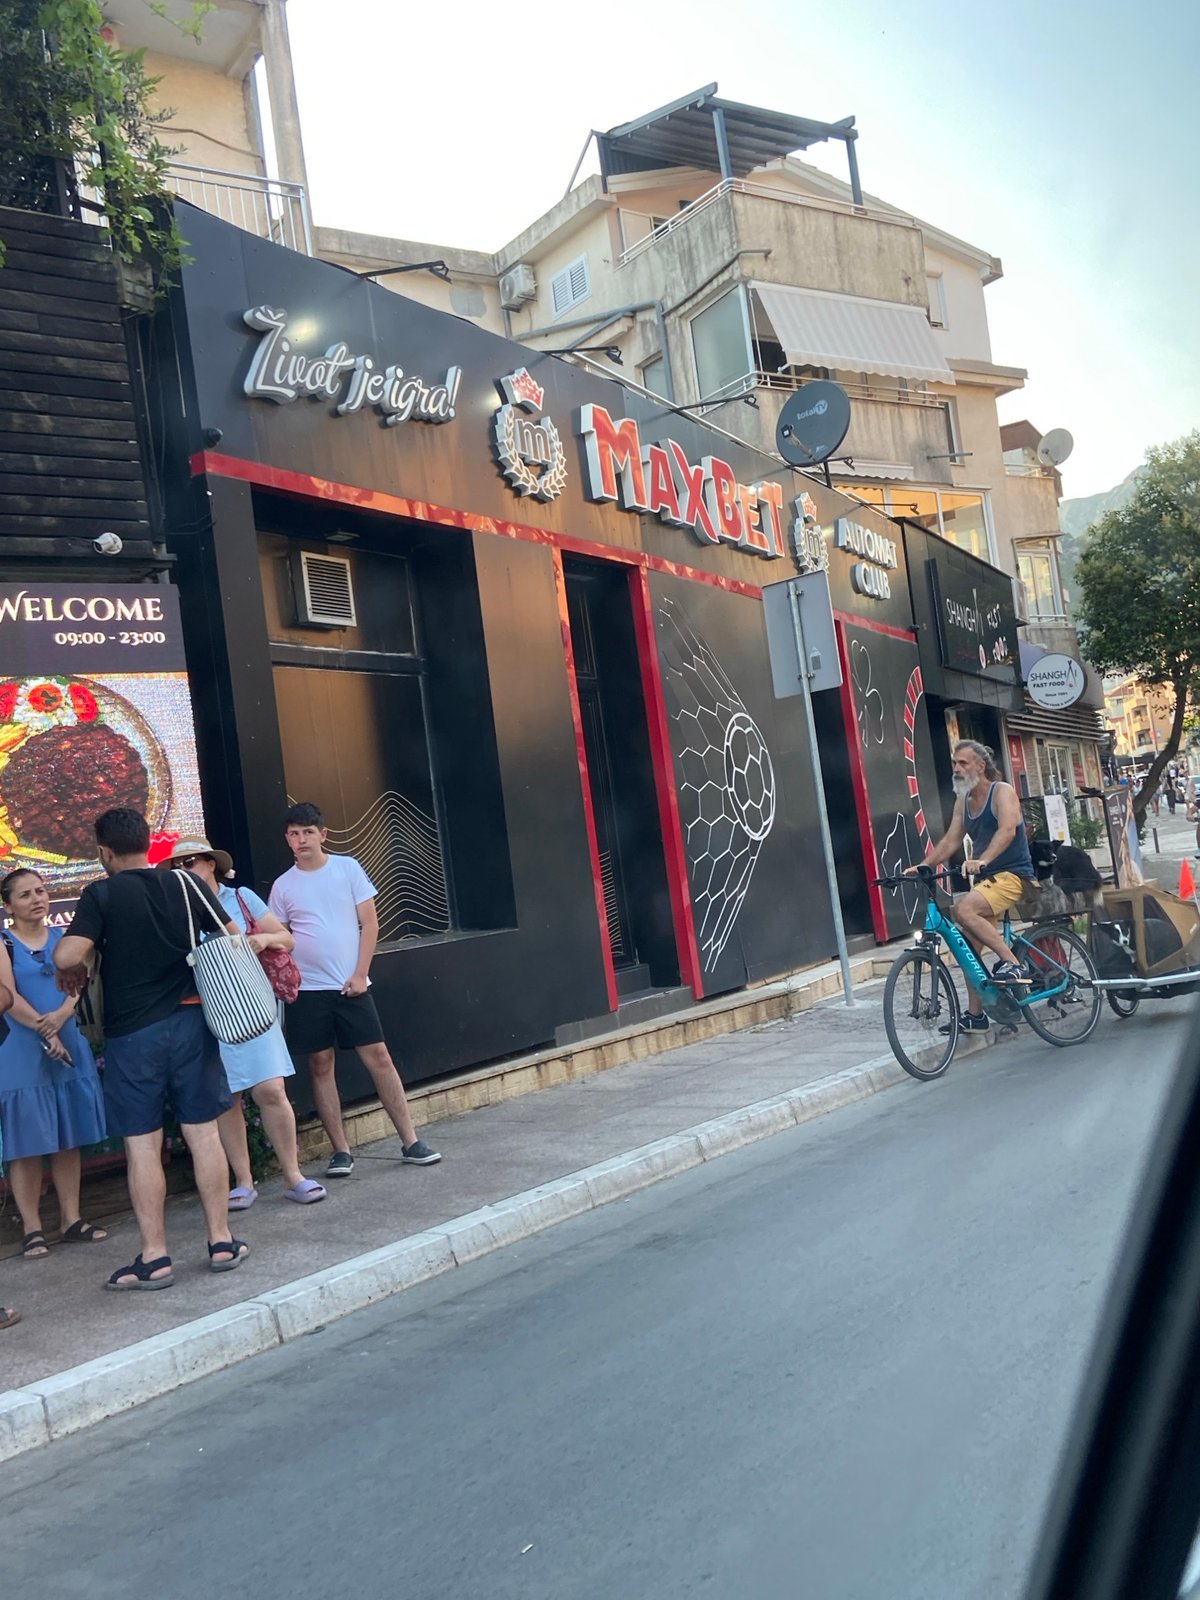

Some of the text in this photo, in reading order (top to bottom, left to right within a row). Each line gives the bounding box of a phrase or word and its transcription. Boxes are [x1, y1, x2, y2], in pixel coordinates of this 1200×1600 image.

[246, 305, 461, 424] Život je igra!
[838, 518, 897, 568] AUTOMAT
[856, 562, 890, 599] CLUB
[0, 590, 164, 622] WELCOME
[55, 632, 105, 646] 09:00
[119, 632, 166, 646] 23:00
[1030, 662, 1077, 681] SHANGHAI
[950, 926, 987, 981] VICTORIA
